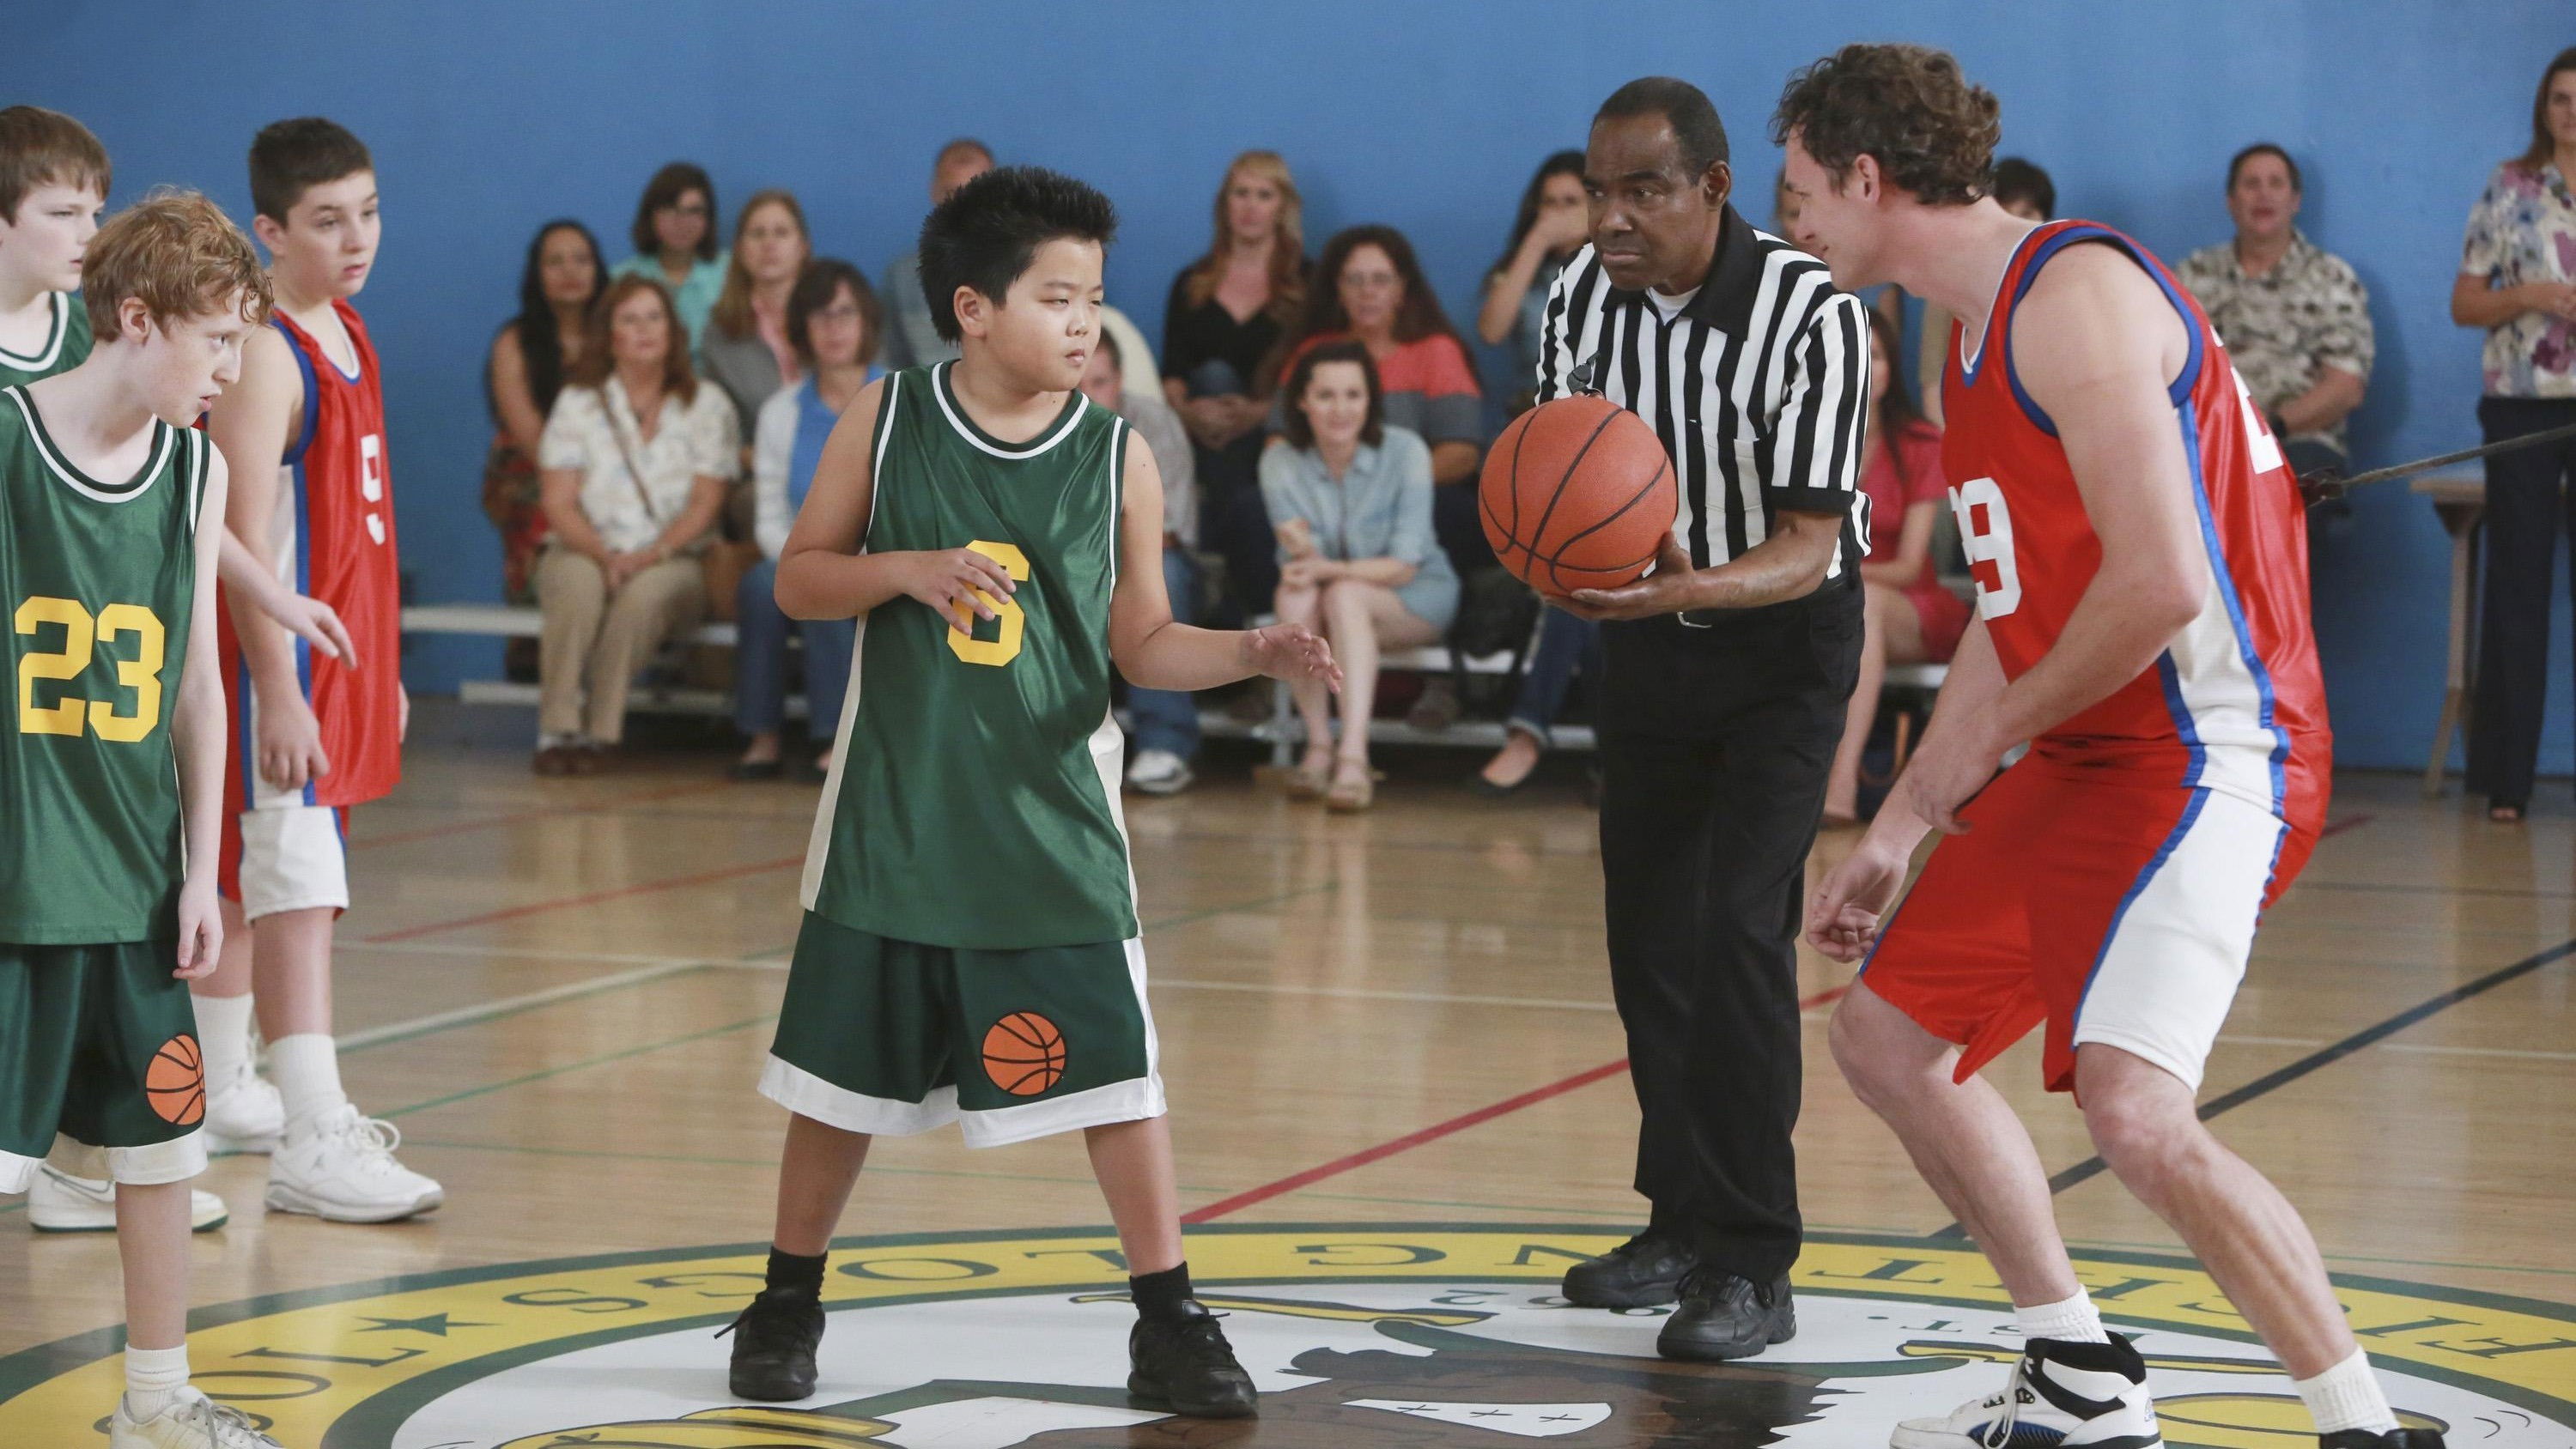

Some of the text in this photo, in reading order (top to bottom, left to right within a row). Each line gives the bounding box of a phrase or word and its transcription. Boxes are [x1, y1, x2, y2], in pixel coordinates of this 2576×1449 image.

[947, 540, 1030, 667] 6
[1948, 477, 2021, 621] 9
[15, 597, 165, 743] 23
